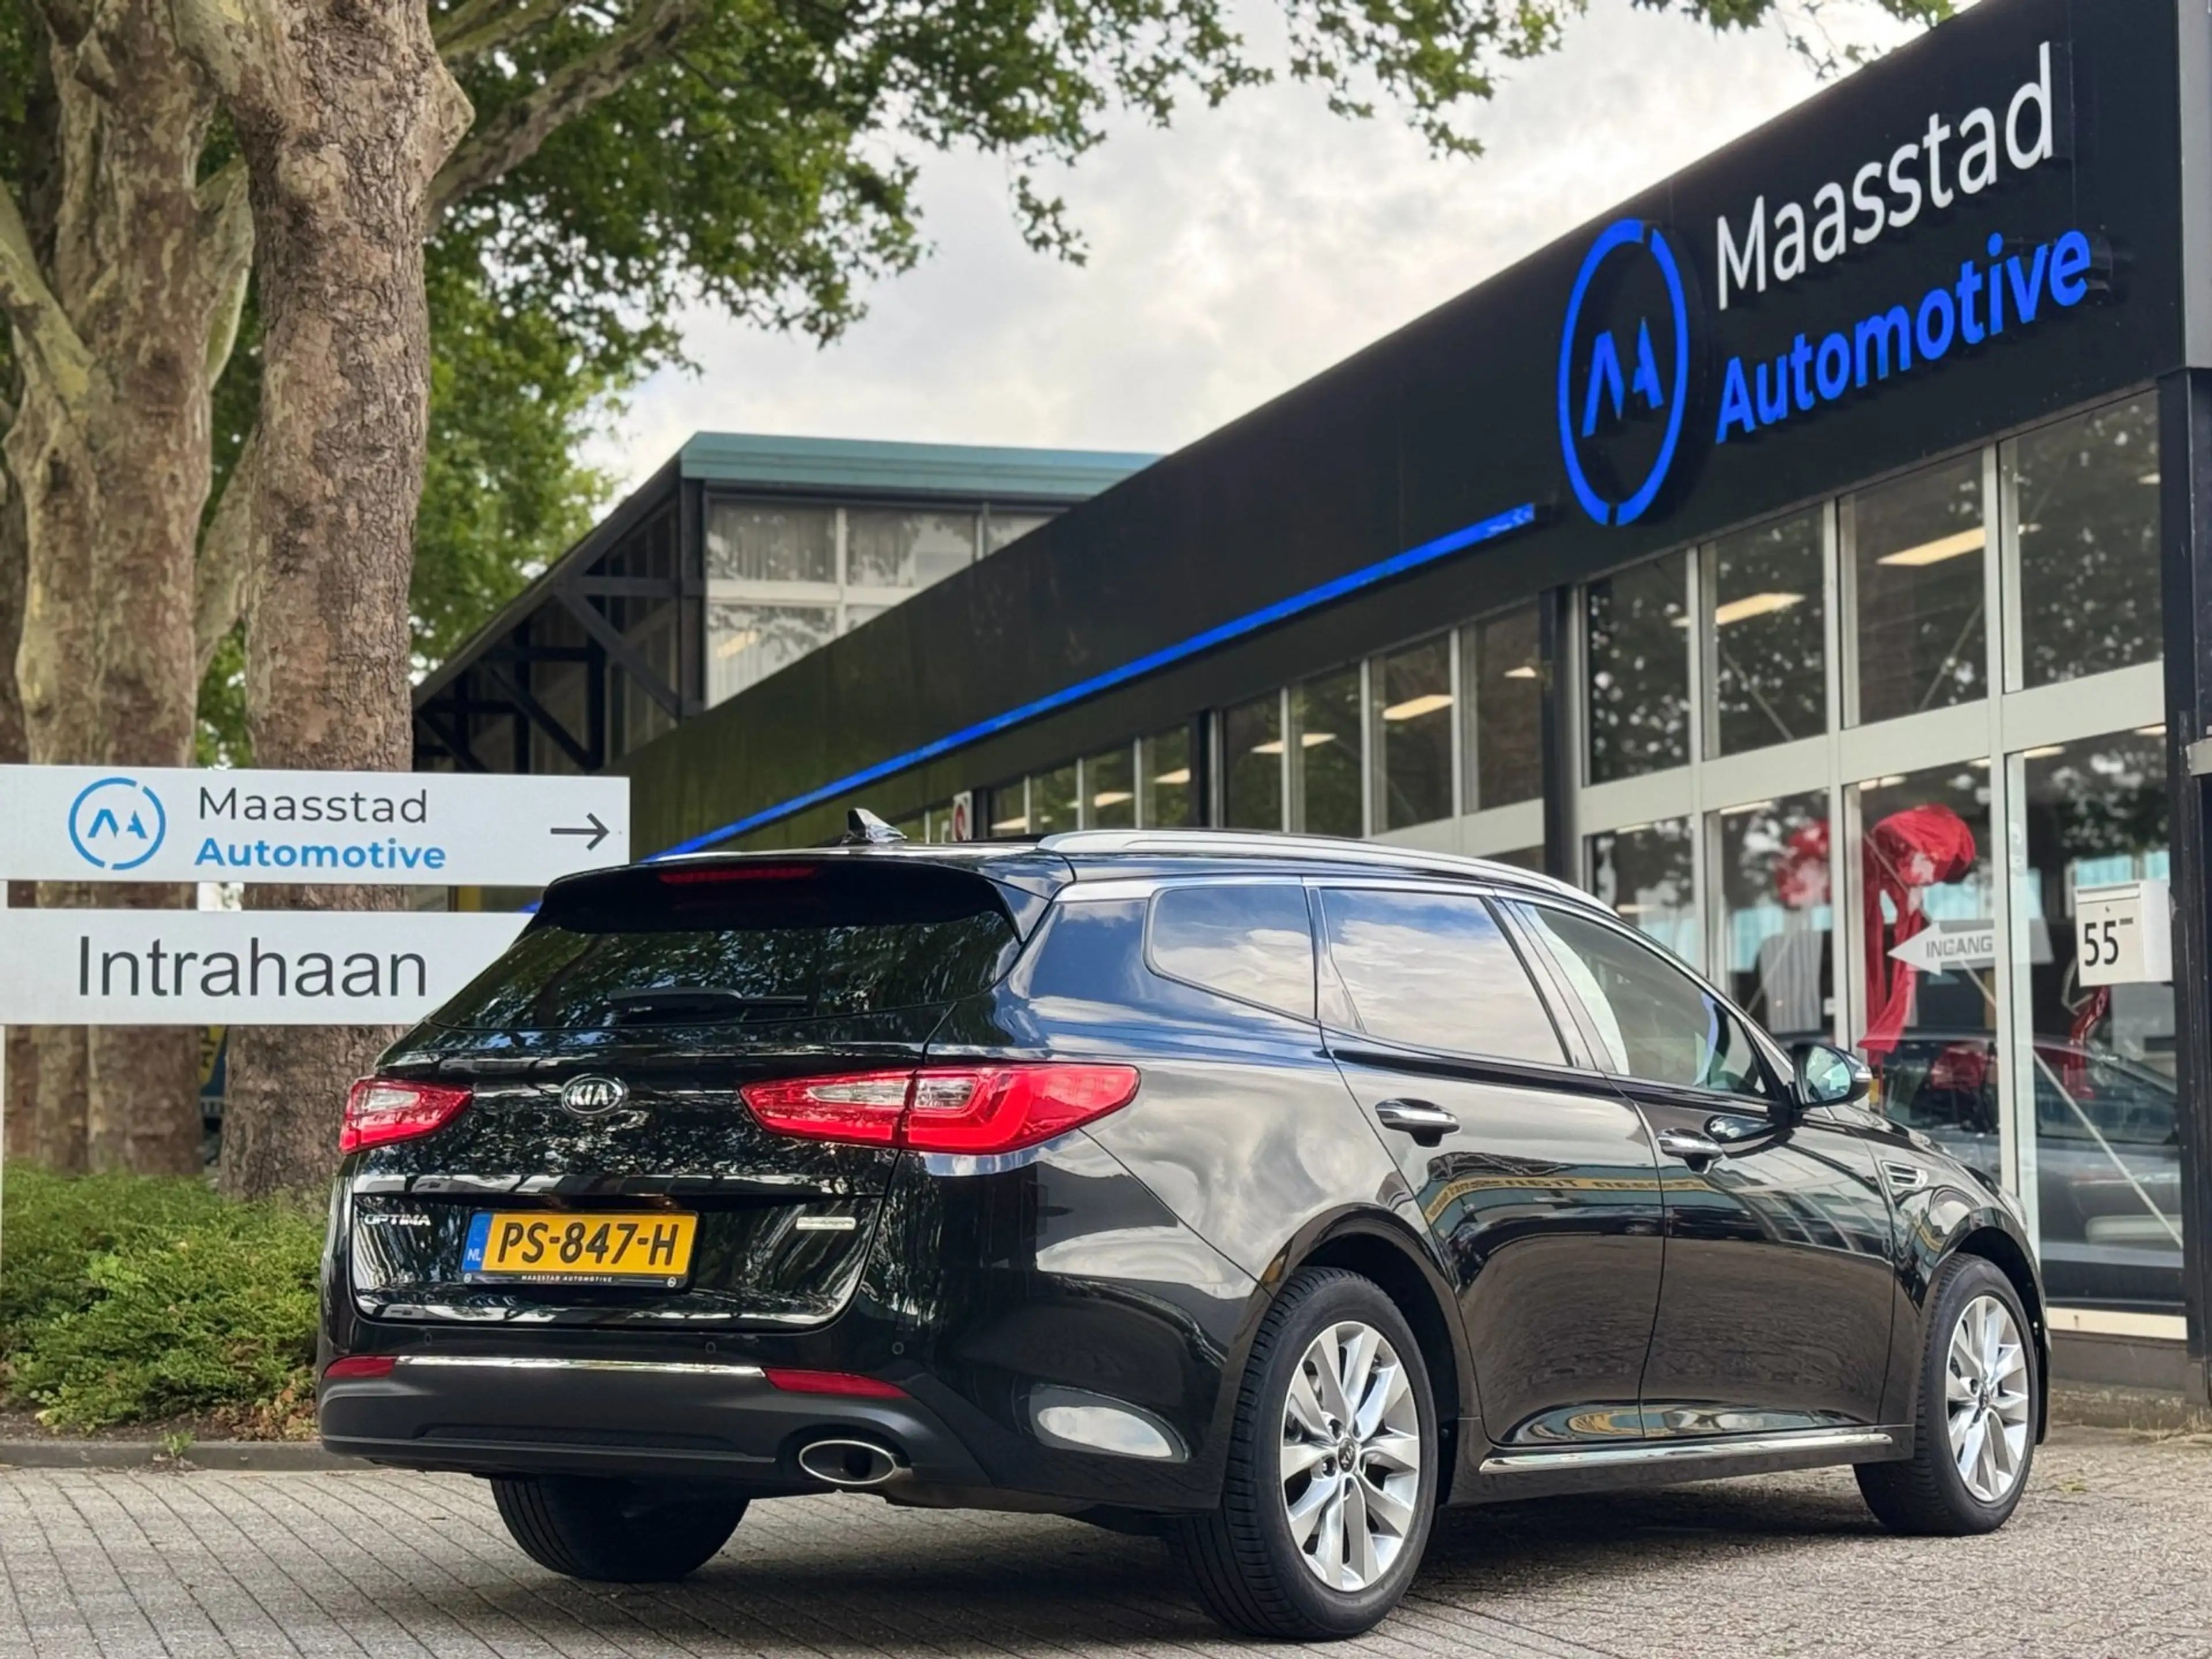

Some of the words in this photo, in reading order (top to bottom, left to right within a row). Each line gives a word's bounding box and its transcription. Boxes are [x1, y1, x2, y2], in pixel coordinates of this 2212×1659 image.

[1717, 41, 2052, 310] Maasstad
[1716, 230, 2091, 443] Automotive
[200, 786, 427, 824] Maasstad
[195, 837, 446, 869] Automotive
[1926, 935, 1993, 959] INGANG
[2084, 921, 2119, 968] 55
[79, 936, 426, 998] Intrahaan
[570, 1084, 609, 1105] KIA
[364, 1213, 431, 1226] OPTIMA
[467, 1248, 482, 1262] NL
[497, 1222, 679, 1266] PS-847-H
